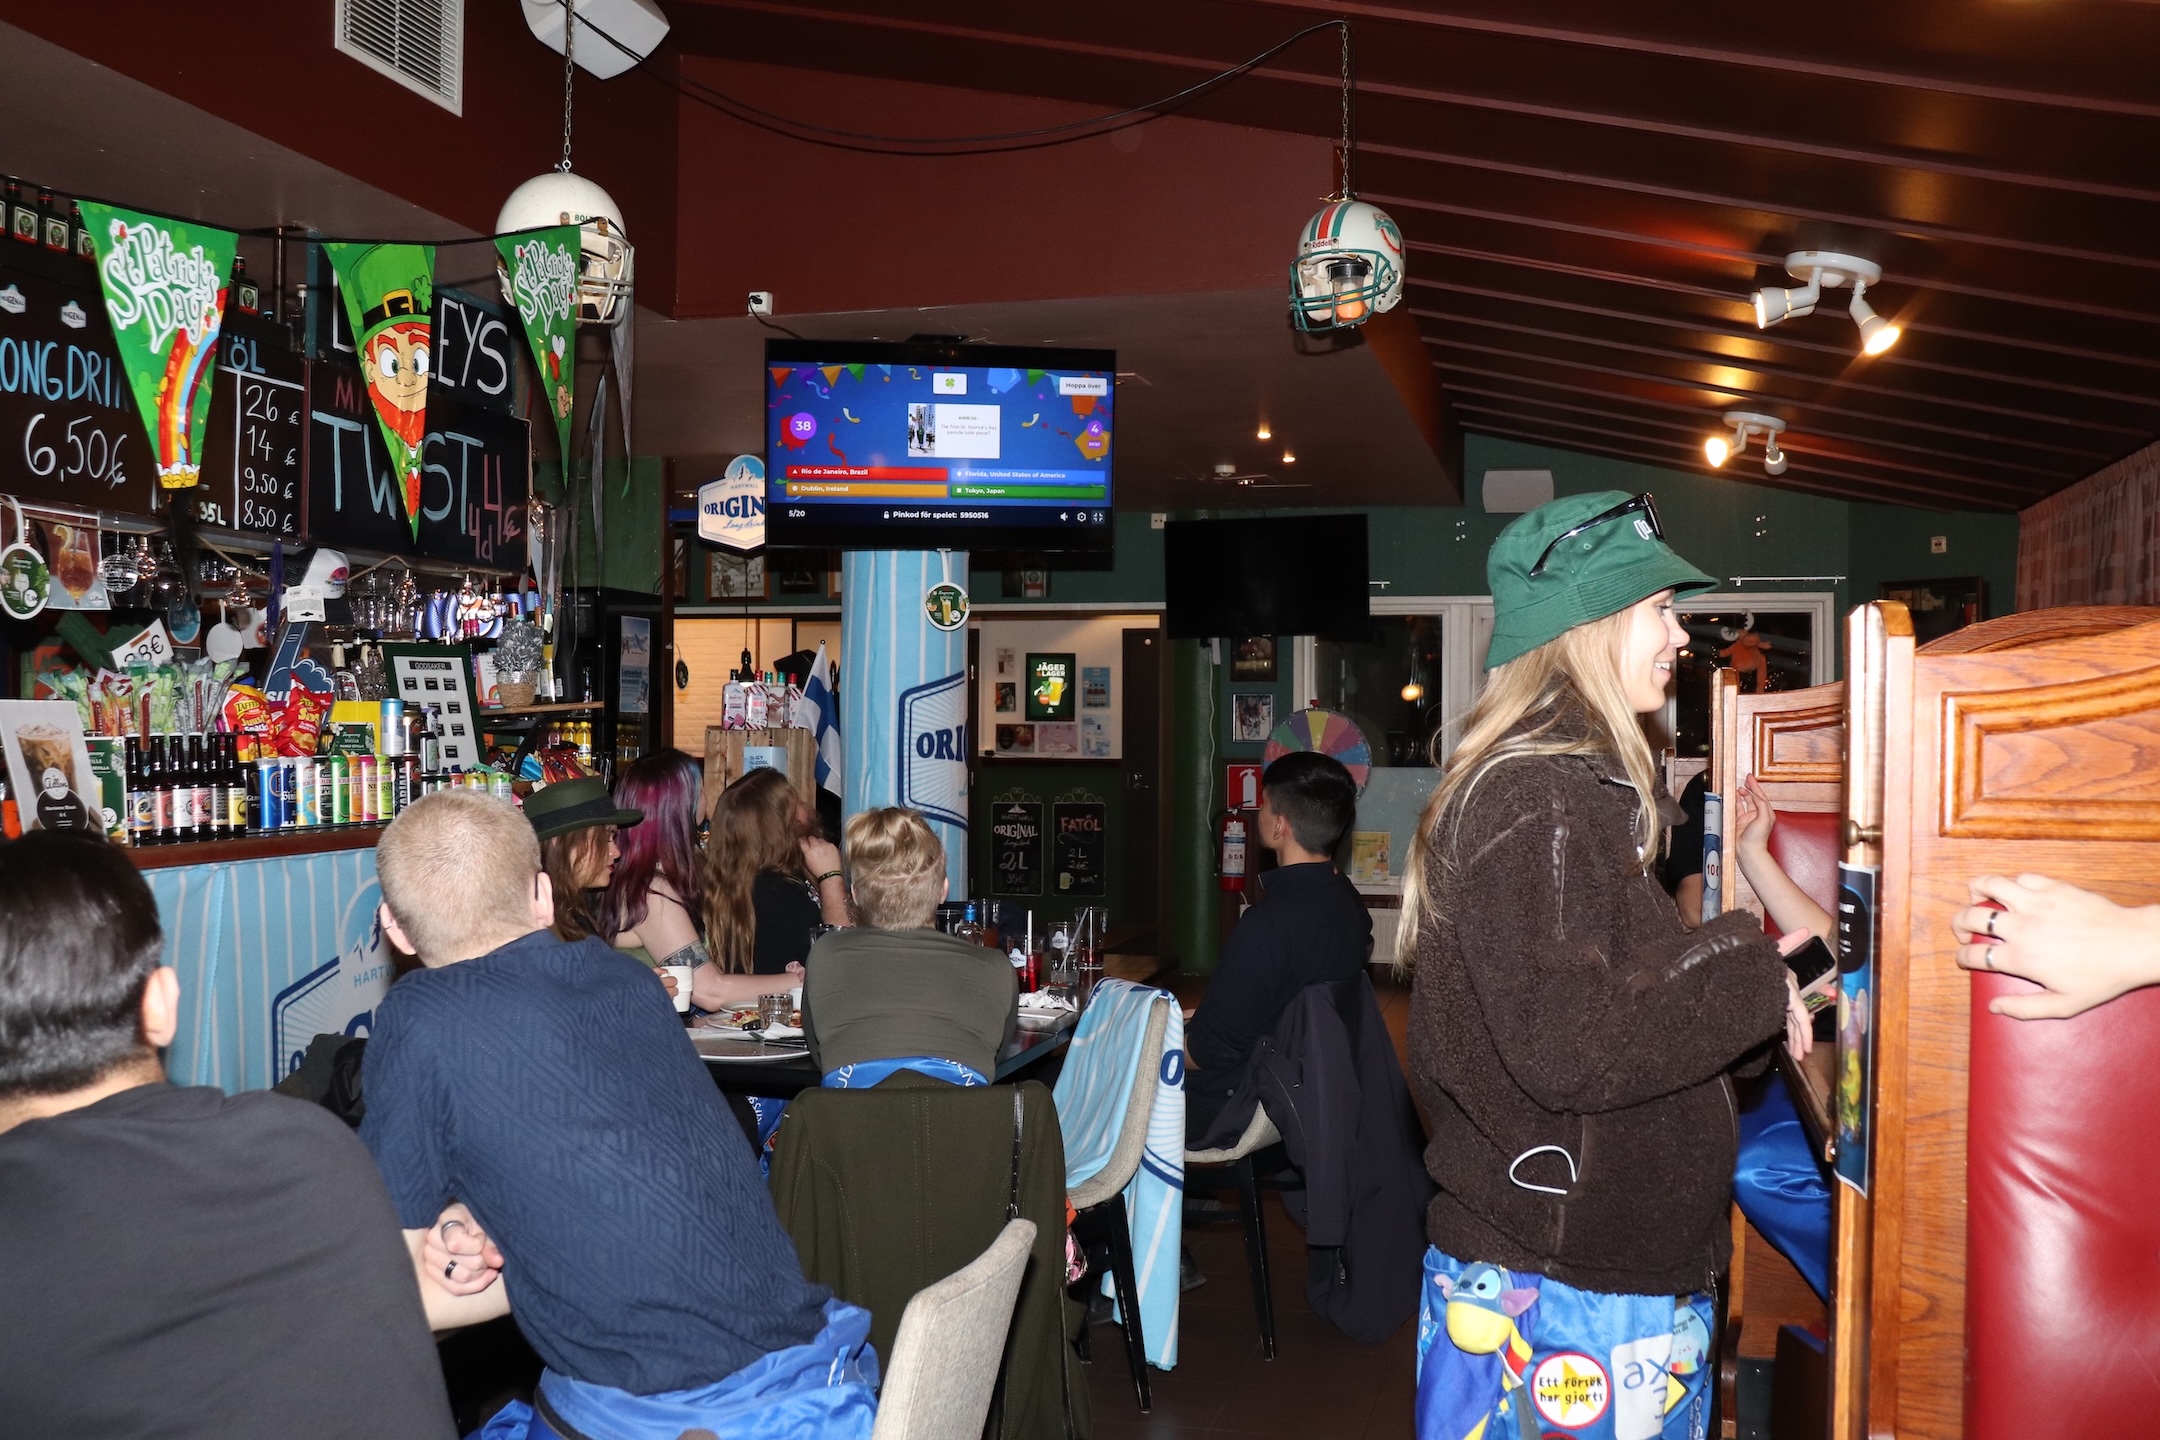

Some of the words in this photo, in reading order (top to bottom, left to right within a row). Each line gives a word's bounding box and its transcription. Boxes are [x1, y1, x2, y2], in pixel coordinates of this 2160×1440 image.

[128, 223, 219, 303] Patrick's
[526, 239, 576, 285] Patrick's
[536, 281, 572, 336] Day
[140, 285, 203, 353] Day
[1065, 382, 1086, 390] Hoppa
[245, 384, 279, 422] 26
[288, 411, 300, 425] €
[795, 421, 812, 432] 38
[1091, 424, 1099, 433] 4
[248, 424, 274, 462] 14
[284, 448, 297, 467] €
[311, 410, 485, 535] TWST
[243, 466, 278, 496] 9,50
[283, 482, 295, 499] €
[242, 498, 277, 529] 8,50
[281, 512, 294, 533] €
[788, 509, 806, 517] 5/20
[933, 511, 957, 520] spelet:
[414, 661, 447, 670] GODSAKER
[1036, 662, 1066, 671] JÄGER
[234, 699, 260, 713] TAFFEL
[994, 823, 1039, 840] ORIGINAL
[1060, 815, 1102, 833] FATÖL
[1068, 860, 1089, 870] 26€
[1539, 1376, 1559, 1388] Ett
[1564, 1376, 1604, 1389] försök
[1539, 1391, 1562, 1403] har
[1565, 1391, 1604, 1406] gjorts
